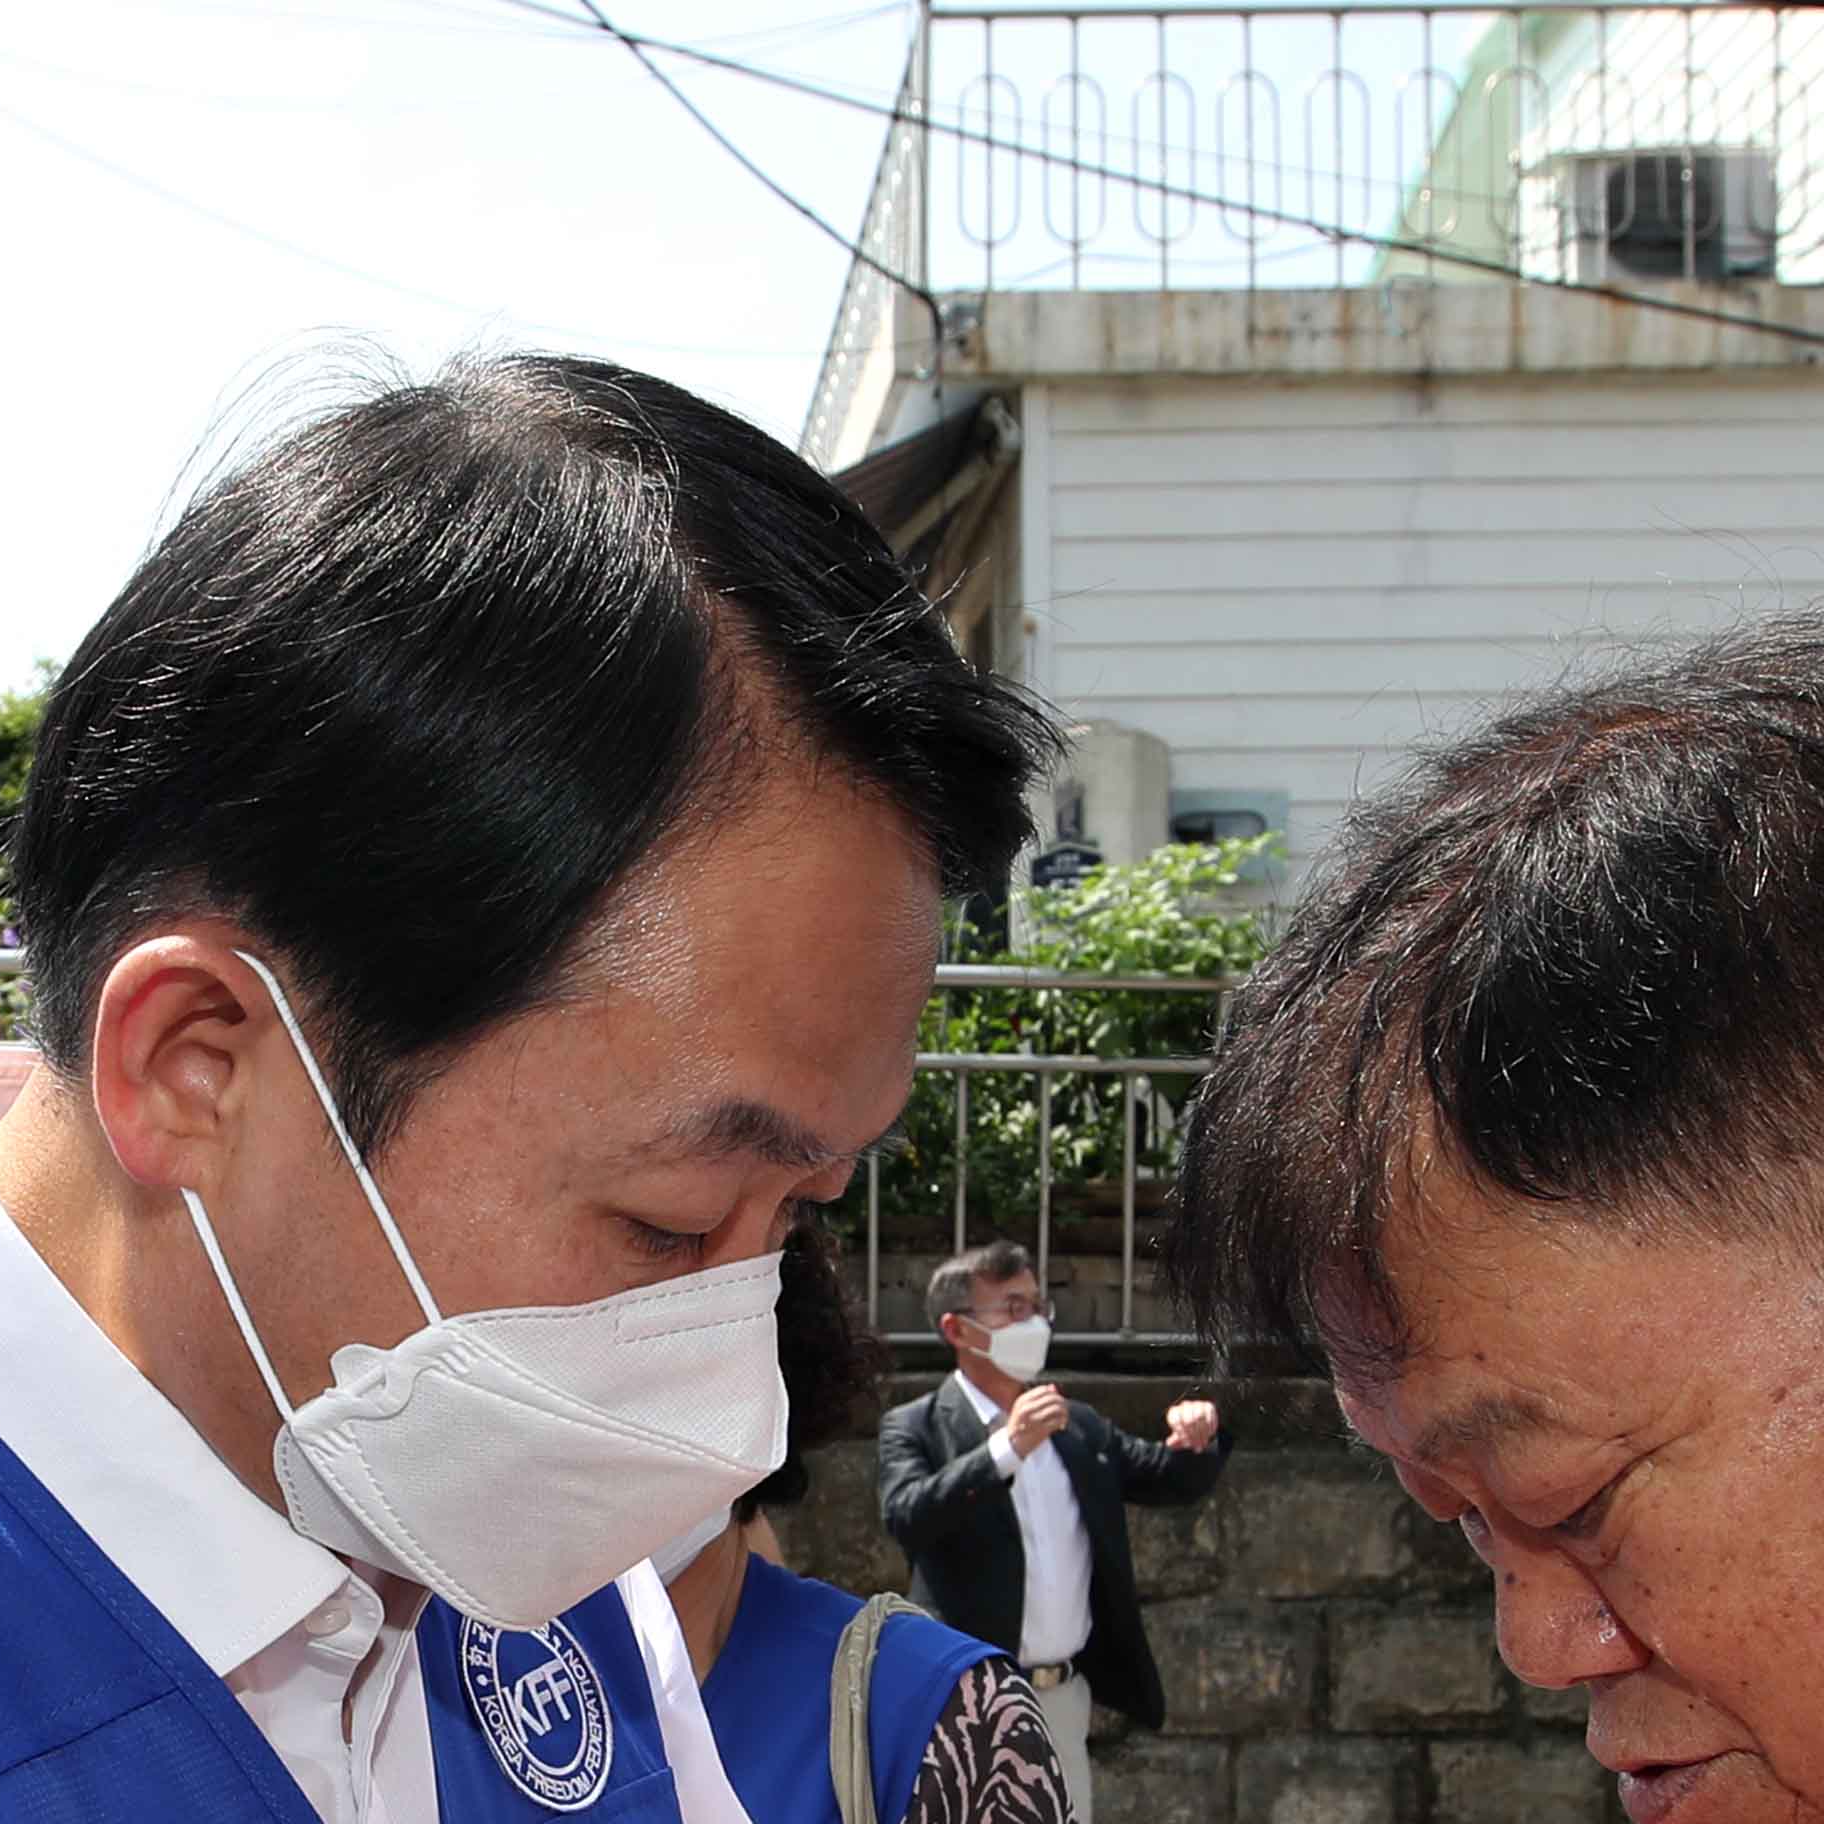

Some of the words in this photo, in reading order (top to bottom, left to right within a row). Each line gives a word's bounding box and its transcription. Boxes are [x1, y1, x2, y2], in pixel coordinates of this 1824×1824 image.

[480, 1694, 526, 1772] KOREA
[526, 1768, 593, 1801] FREEDOM
[564, 1648, 606, 1782] FEDERATION
[502, 1658, 574, 1744] KFF
